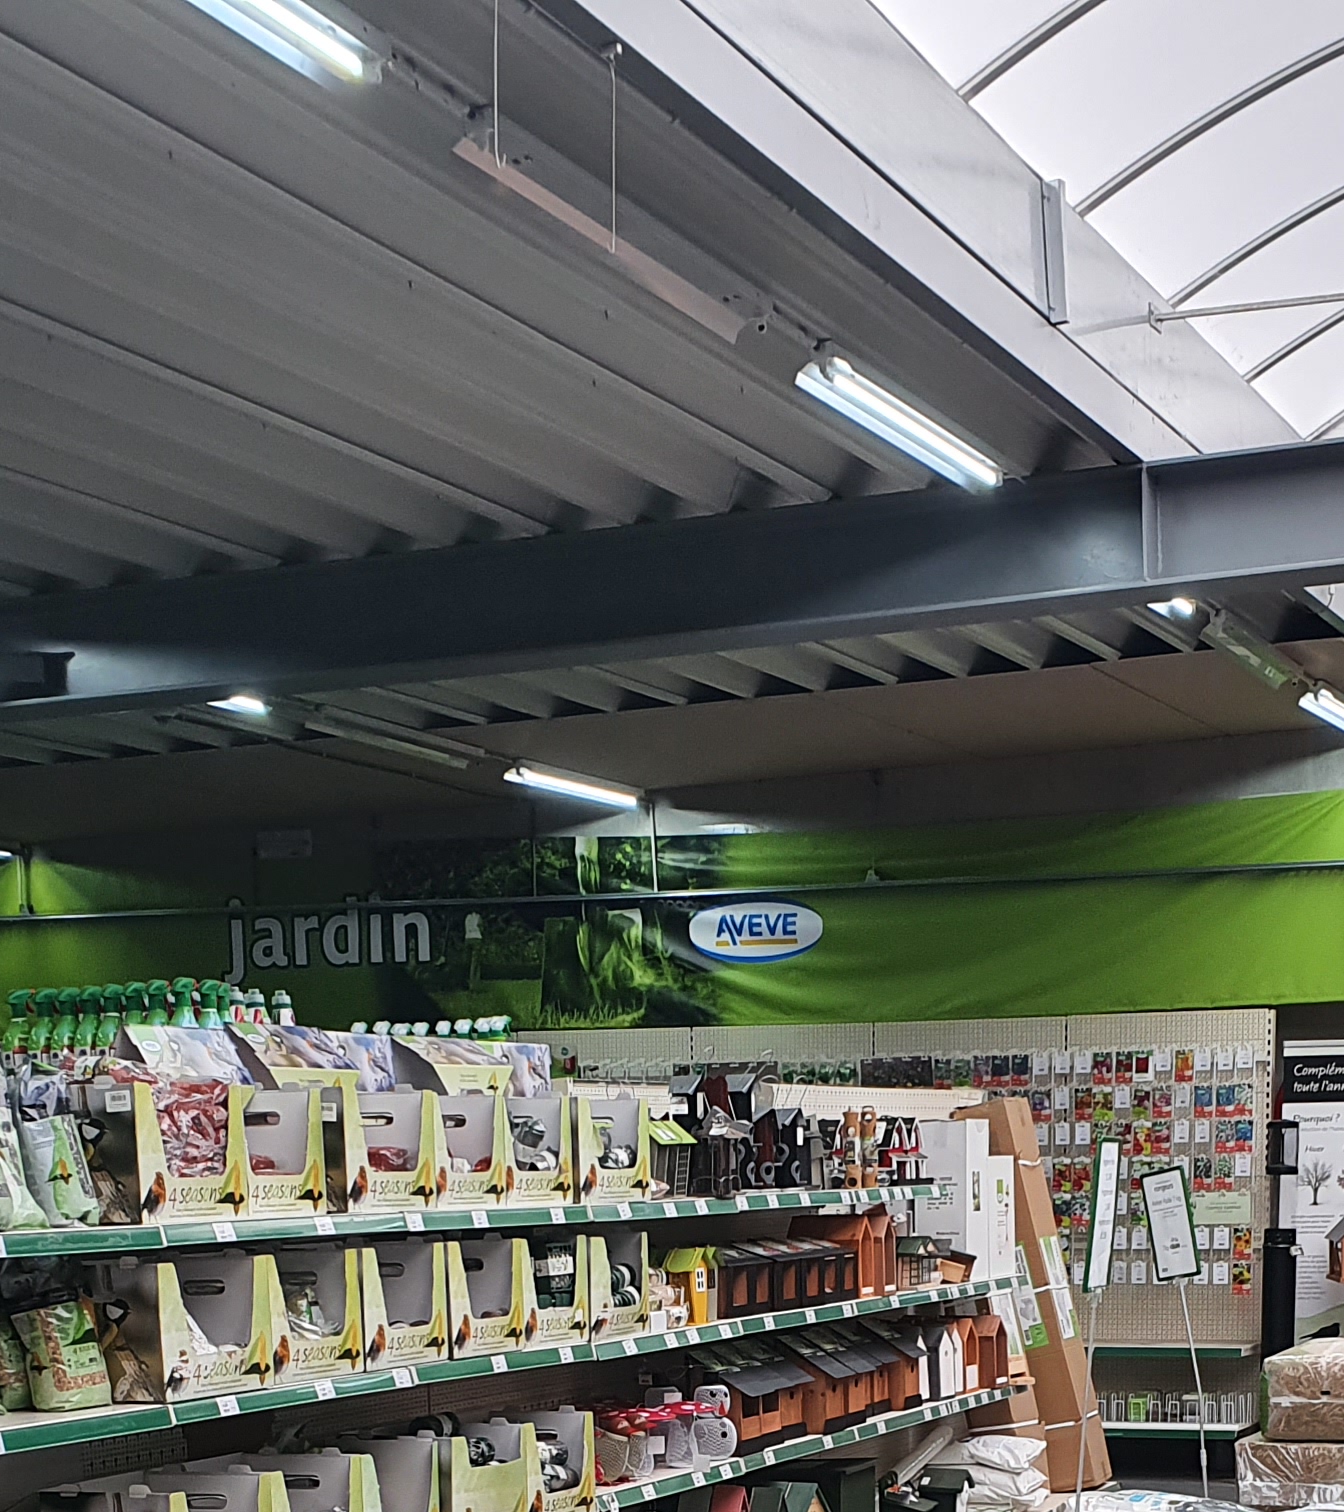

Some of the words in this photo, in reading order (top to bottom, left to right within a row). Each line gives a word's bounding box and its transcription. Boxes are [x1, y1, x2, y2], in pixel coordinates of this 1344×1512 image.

[715, 911, 798, 946] AVEVE
[223, 896, 431, 986] jardin
[1293, 1081, 1319, 1093] toute
[1293, 1114, 1333, 1126] Pourquoi
